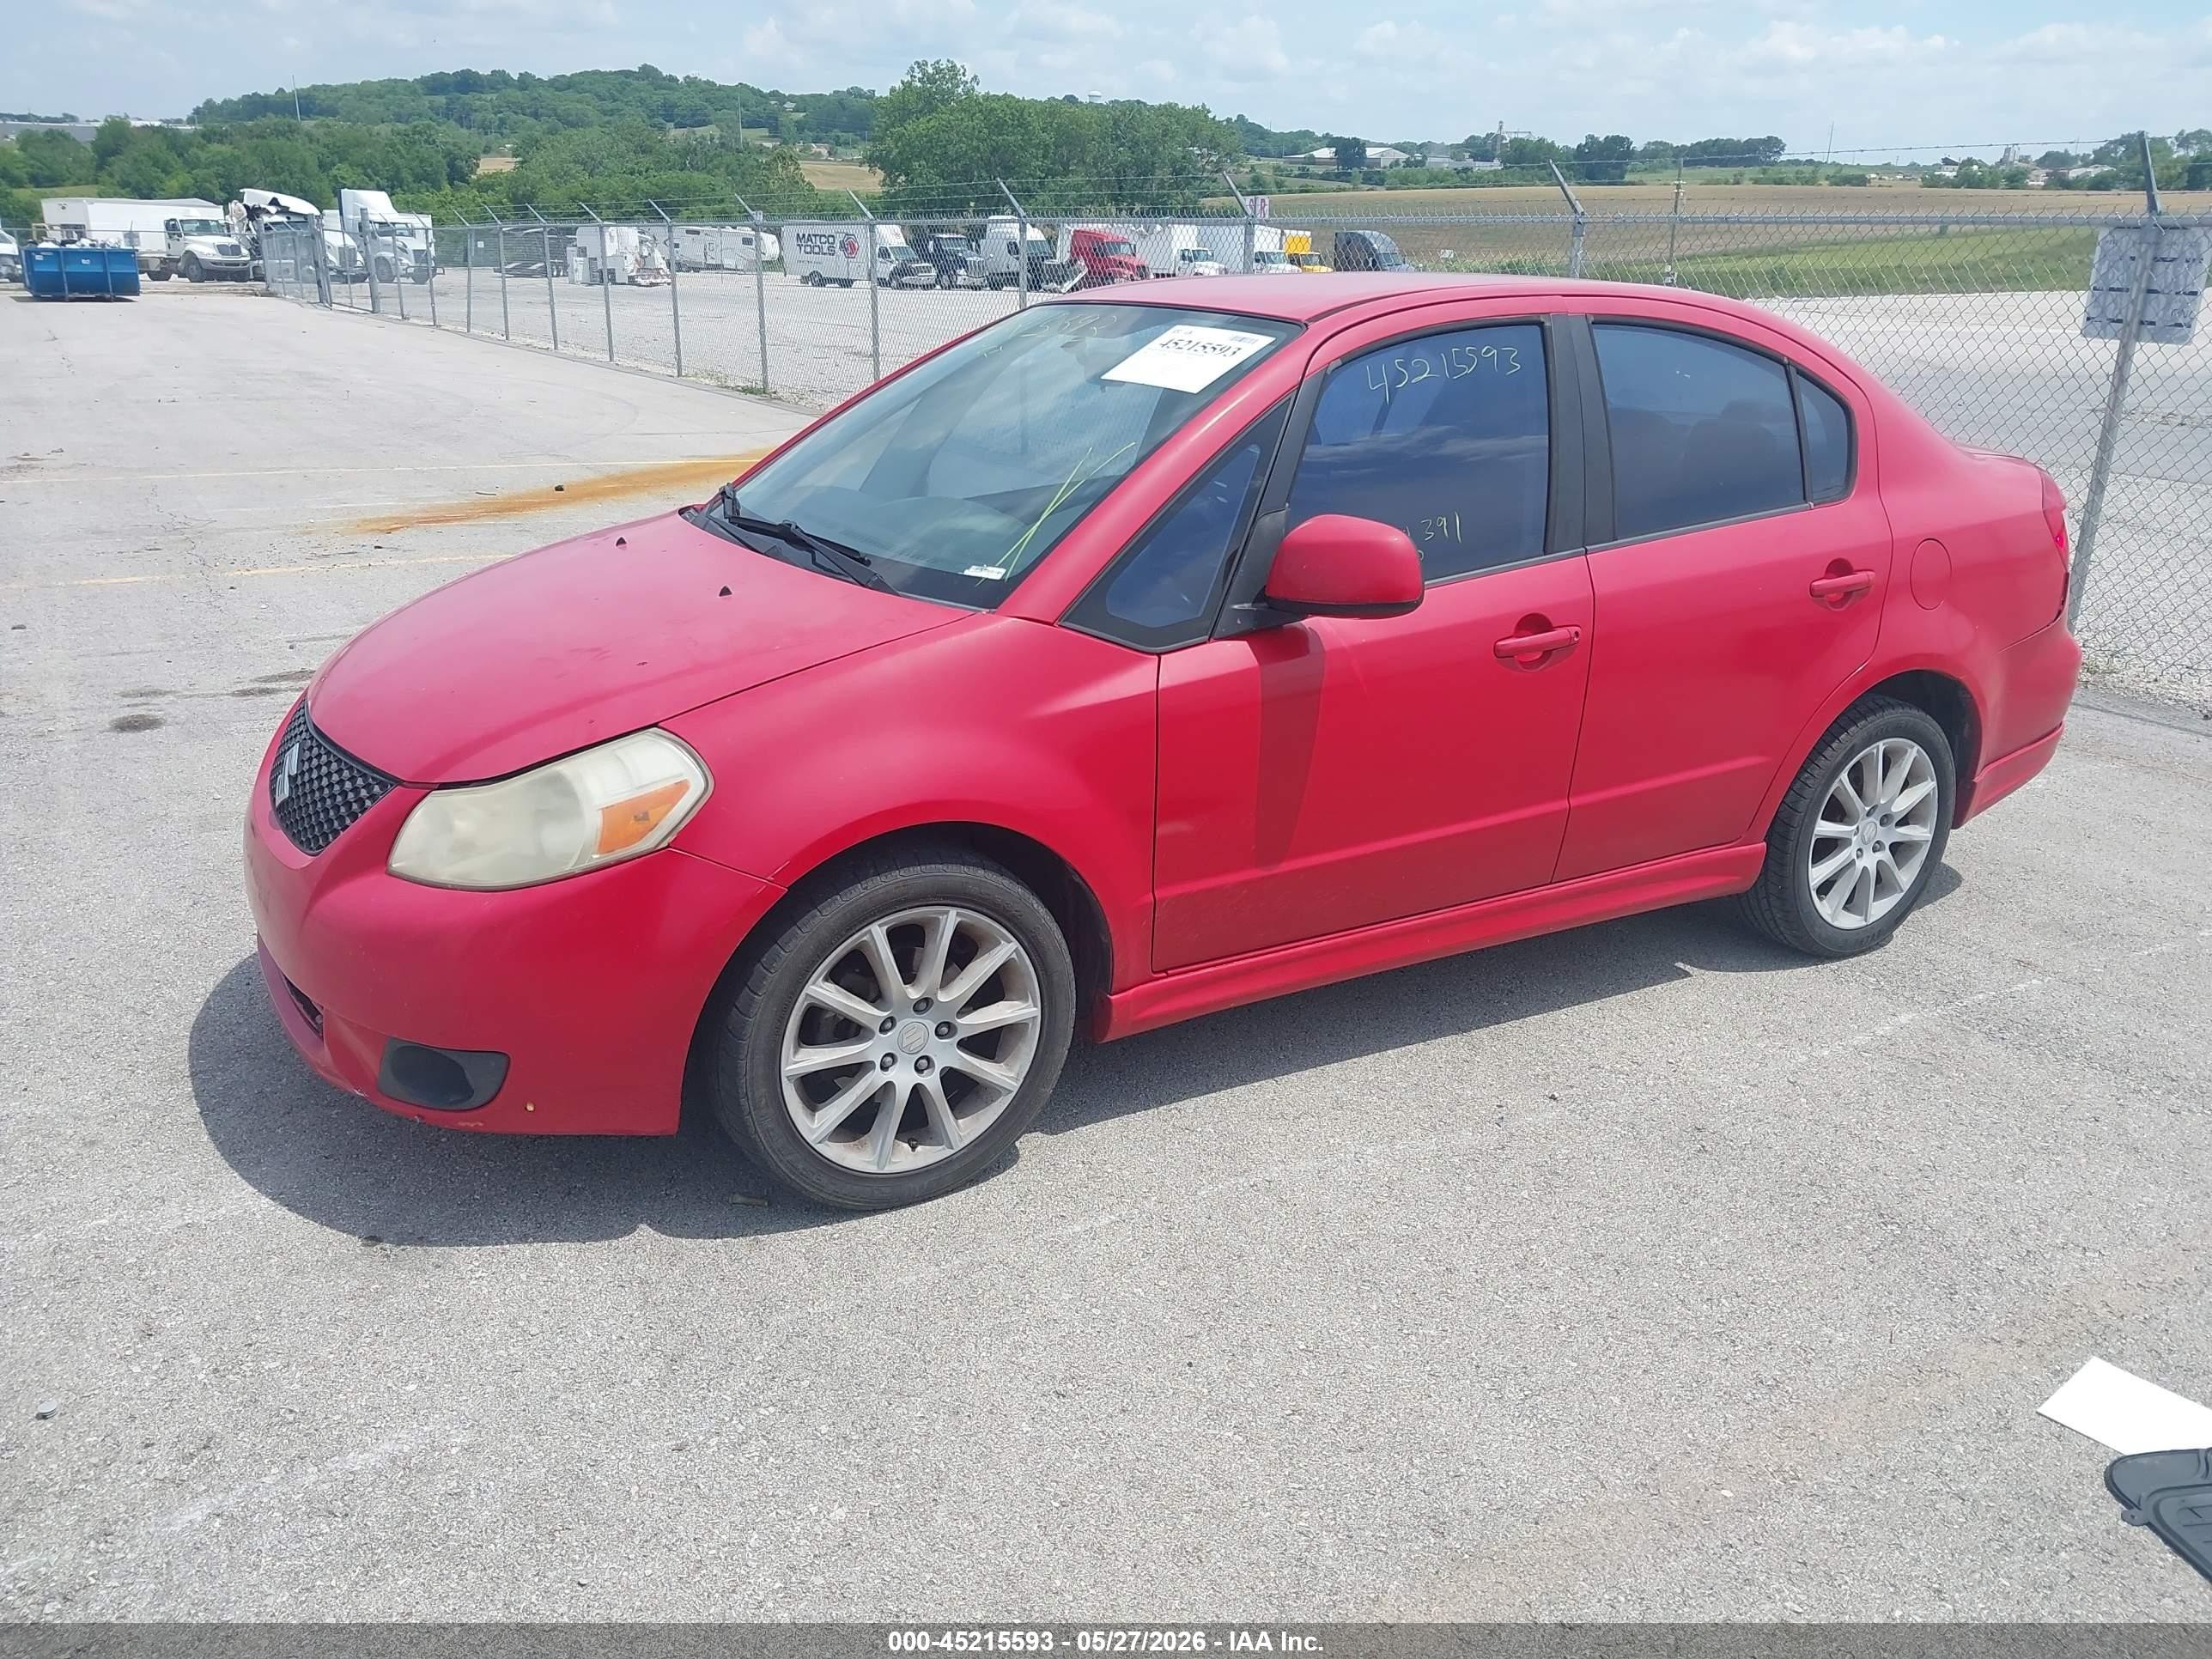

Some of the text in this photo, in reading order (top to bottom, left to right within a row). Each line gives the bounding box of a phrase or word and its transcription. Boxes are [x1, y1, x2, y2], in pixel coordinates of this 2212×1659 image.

[796, 234, 836, 245] MATCO
[796, 244, 836, 256] TOOLS
[1159, 337, 1243, 357] 45215593
[1367, 346, 1522, 404] 45215593
